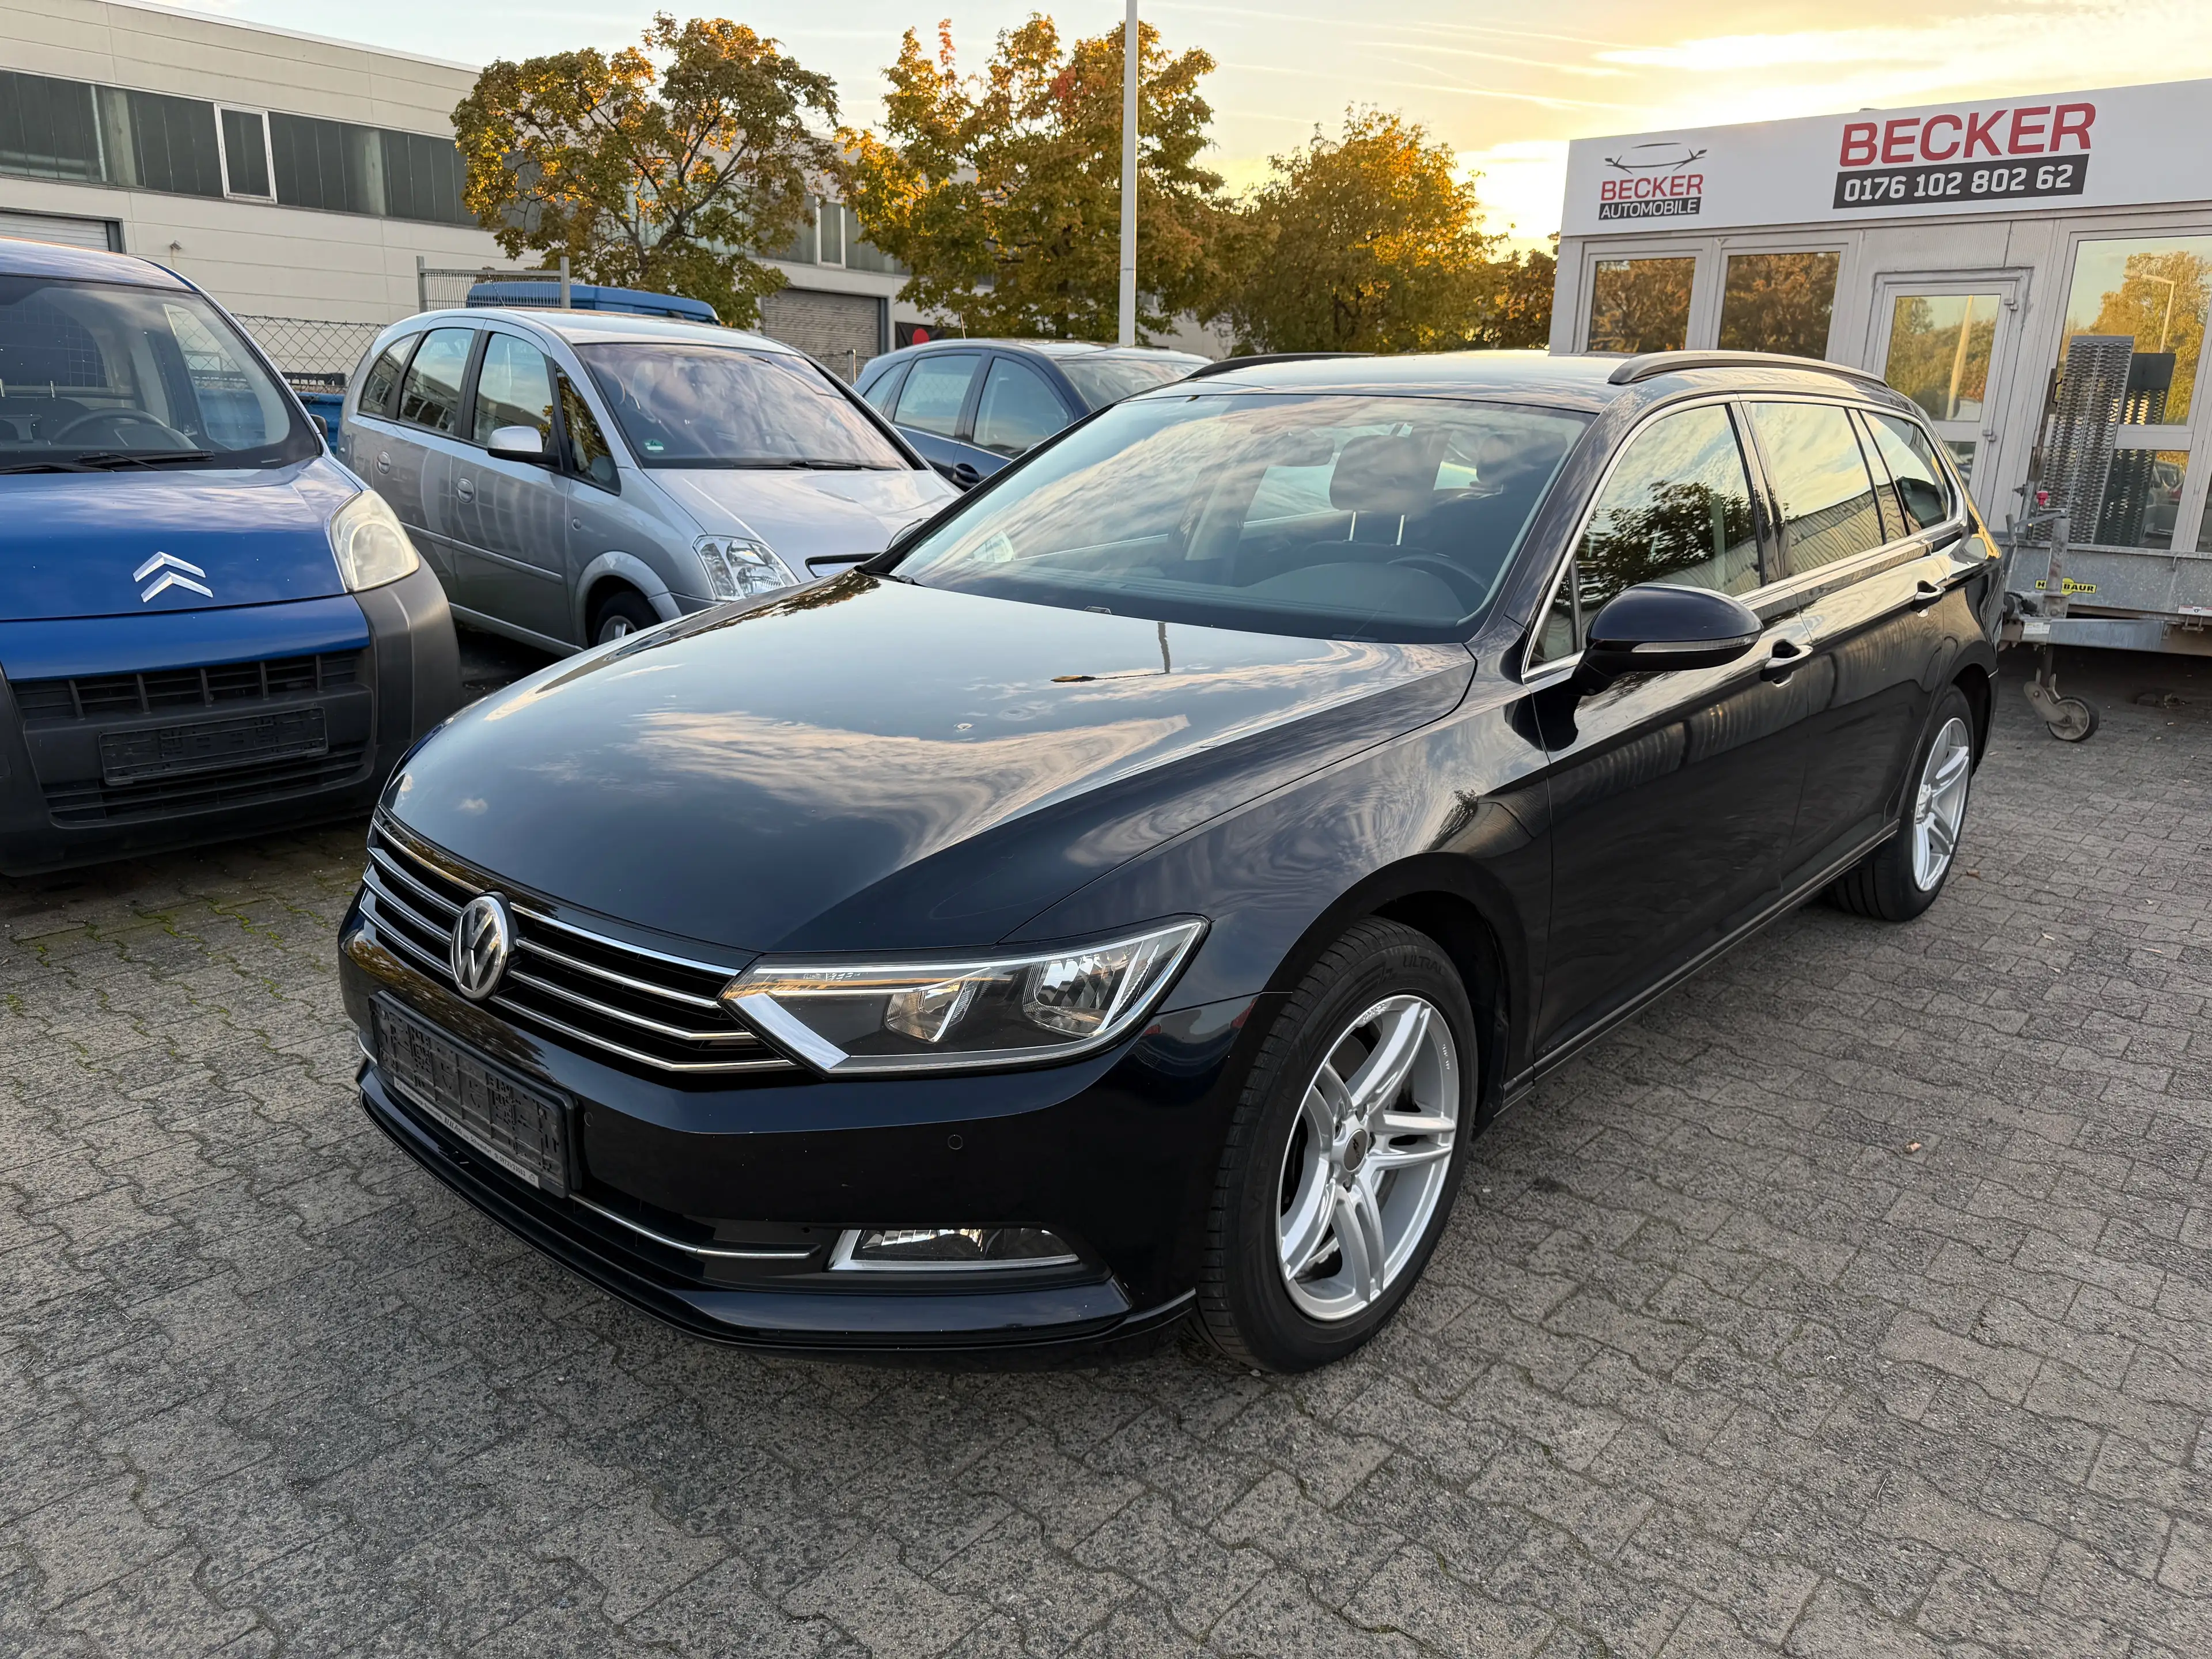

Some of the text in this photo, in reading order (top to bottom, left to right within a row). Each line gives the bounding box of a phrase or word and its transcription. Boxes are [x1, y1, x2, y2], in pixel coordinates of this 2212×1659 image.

[1839, 103, 2096, 167] BECKER
[1601, 174, 1703, 201] BECKER
[1843, 164, 2073, 202] 0176 102 802 62
[1600, 199, 1698, 219] AUTOMOBILE
